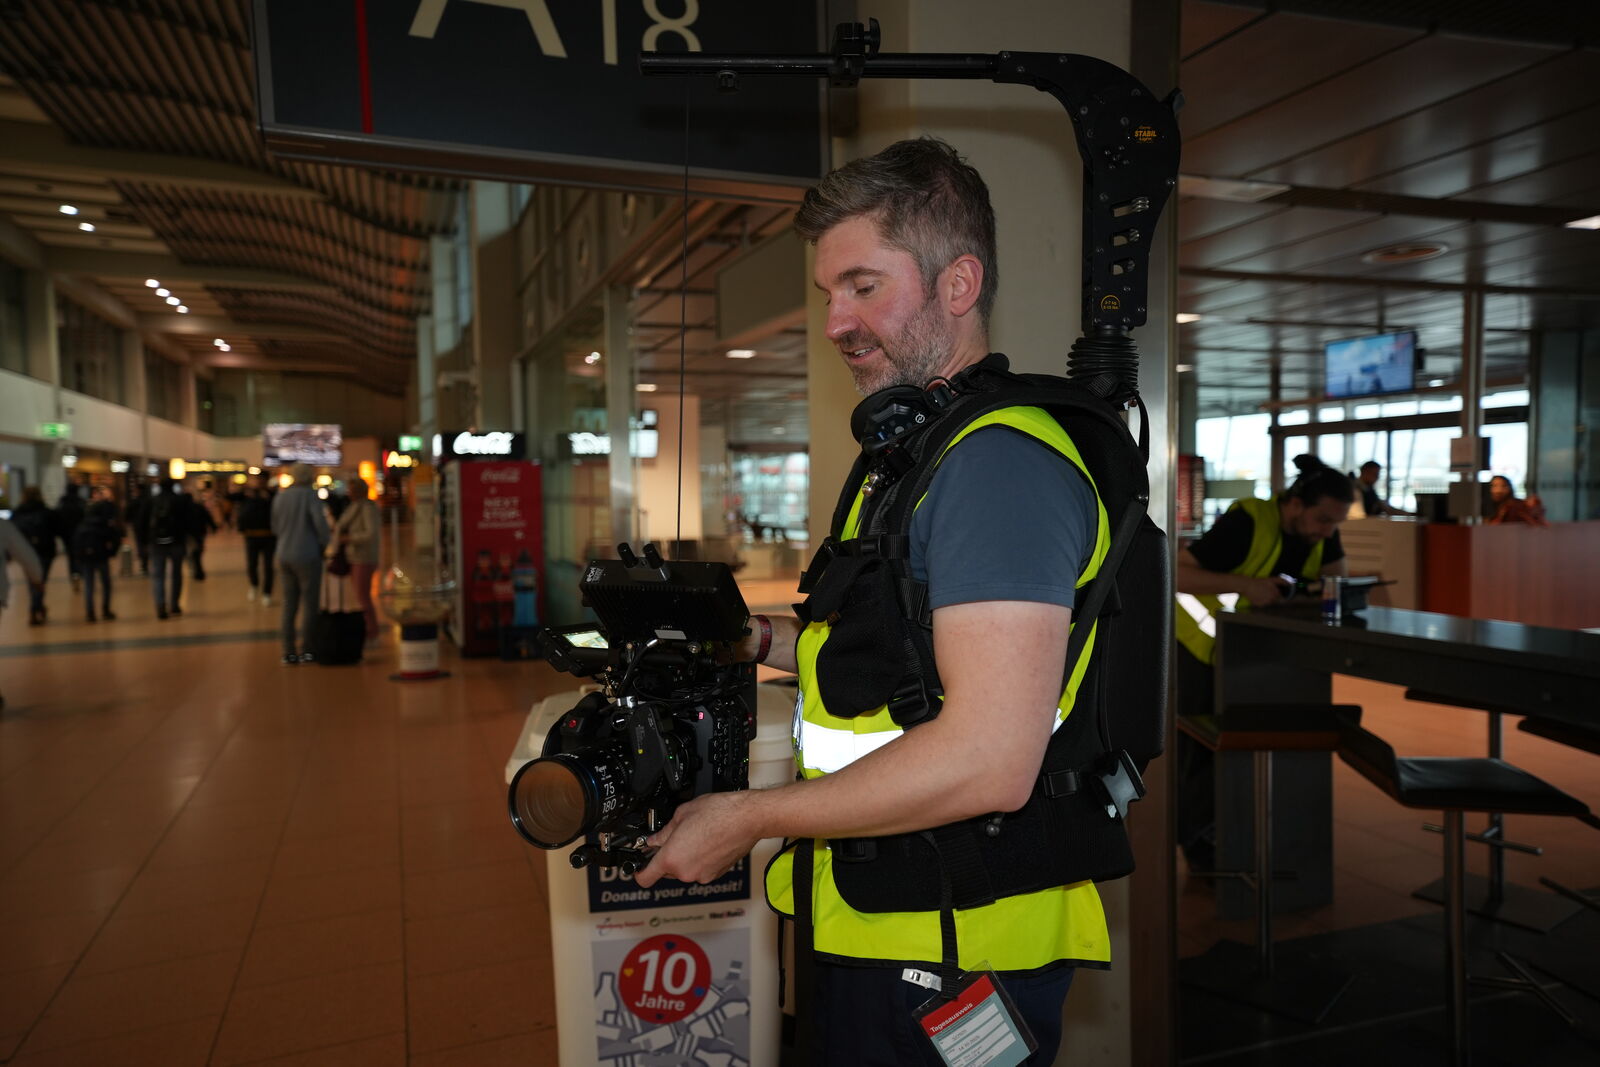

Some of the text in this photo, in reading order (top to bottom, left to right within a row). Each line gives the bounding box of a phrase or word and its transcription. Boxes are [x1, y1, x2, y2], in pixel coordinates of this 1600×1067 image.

[484, 497, 519, 507] NEXT
[604, 781, 616, 797] 75
[602, 798, 617, 814] 180
[600, 880, 744, 904] Donate your deposit!
[637, 949, 697, 996] 10
[634, 993, 686, 1012] Jahre
[930, 1002, 974, 1033] Tagesausweis
